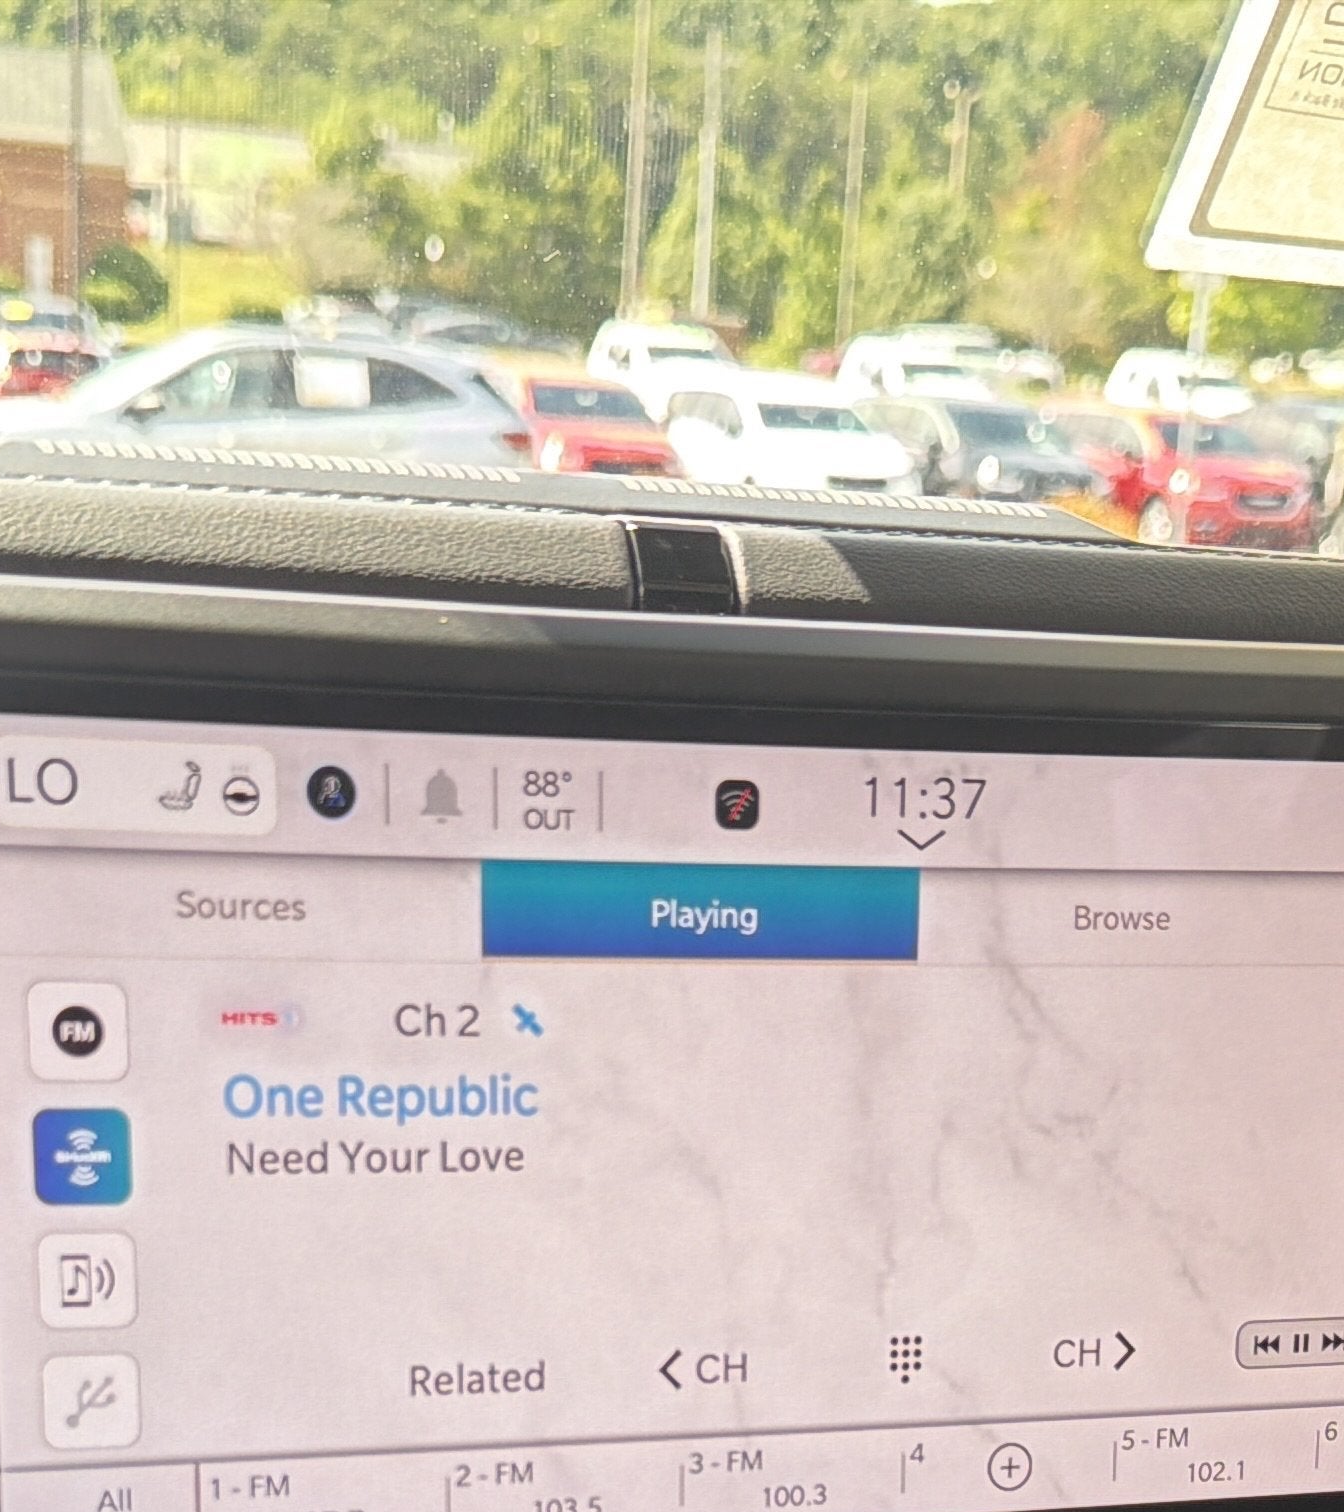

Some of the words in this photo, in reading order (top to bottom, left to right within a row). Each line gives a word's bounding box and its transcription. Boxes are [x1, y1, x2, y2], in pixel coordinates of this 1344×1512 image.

[7, 757, 78, 805] LO
[523, 770, 572, 797] 88°
[865, 777, 987, 821] 11:37
[524, 809, 574, 831] OUT
[176, 890, 306, 922] Sources
[650, 899, 758, 935] Playing
[1074, 905, 1171, 932] Browse
[221, 1011, 278, 1026] HITS
[395, 1005, 450, 1038] Ch
[456, 1005, 481, 1038] 2
[60, 1021, 96, 1044] FM
[223, 1074, 323, 1120] One
[338, 1073, 540, 1125] Republic
[227, 1142, 329, 1175] Need
[339, 1142, 430, 1173] Your
[440, 1142, 525, 1173] Love
[1053, 1339, 1101, 1368] CH
[410, 1361, 546, 1397] Related
[696, 1353, 749, 1385] CH
[1156, 1427, 1189, 1449] FM
[1325, 1421, 1338, 1441] 6
[727, 1450, 763, 1473] FM
[911, 1445, 925, 1464] 4
[495, 1462, 534, 1486] FM
[1187, 1461, 1245, 1484] 102.1
[249, 1475, 290, 1498] FM
[763, 1484, 827, 1508] 100.3
[98, 1489, 133, 1512] All
